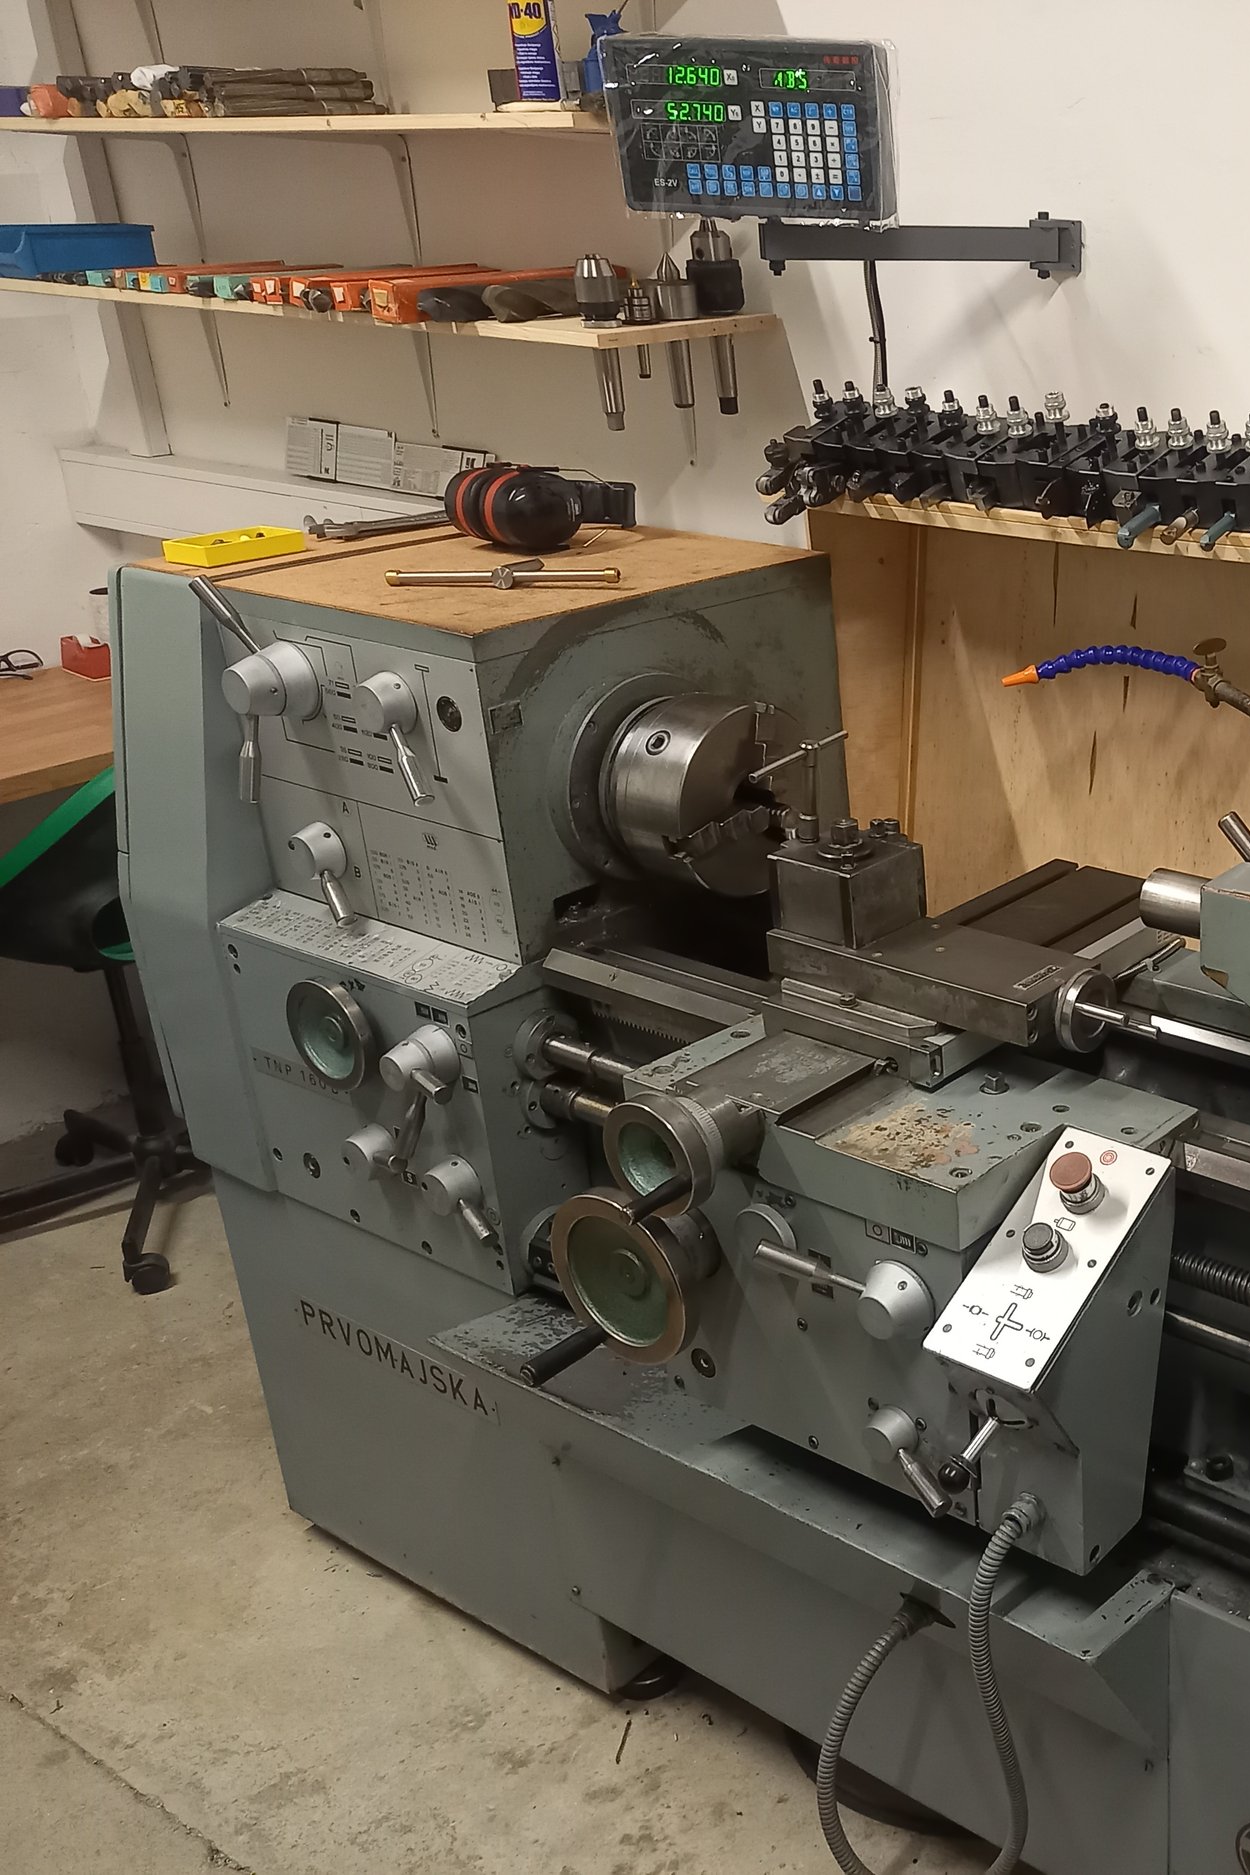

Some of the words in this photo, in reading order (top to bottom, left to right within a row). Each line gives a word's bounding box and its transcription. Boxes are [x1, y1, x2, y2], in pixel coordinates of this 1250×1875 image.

[668, 66, 720, 86] 12.640
[774, 71, 808, 89] ABS
[667, 102, 724, 121] 52.740
[654, 178, 678, 187] ES-2V
[342, 801, 350, 814] A
[354, 865, 361, 878] B
[264, 1056, 292, 1076] TNP
[407, 1173, 413, 1183] S
[300, 1299, 489, 1416] PRVOMAJSKA
